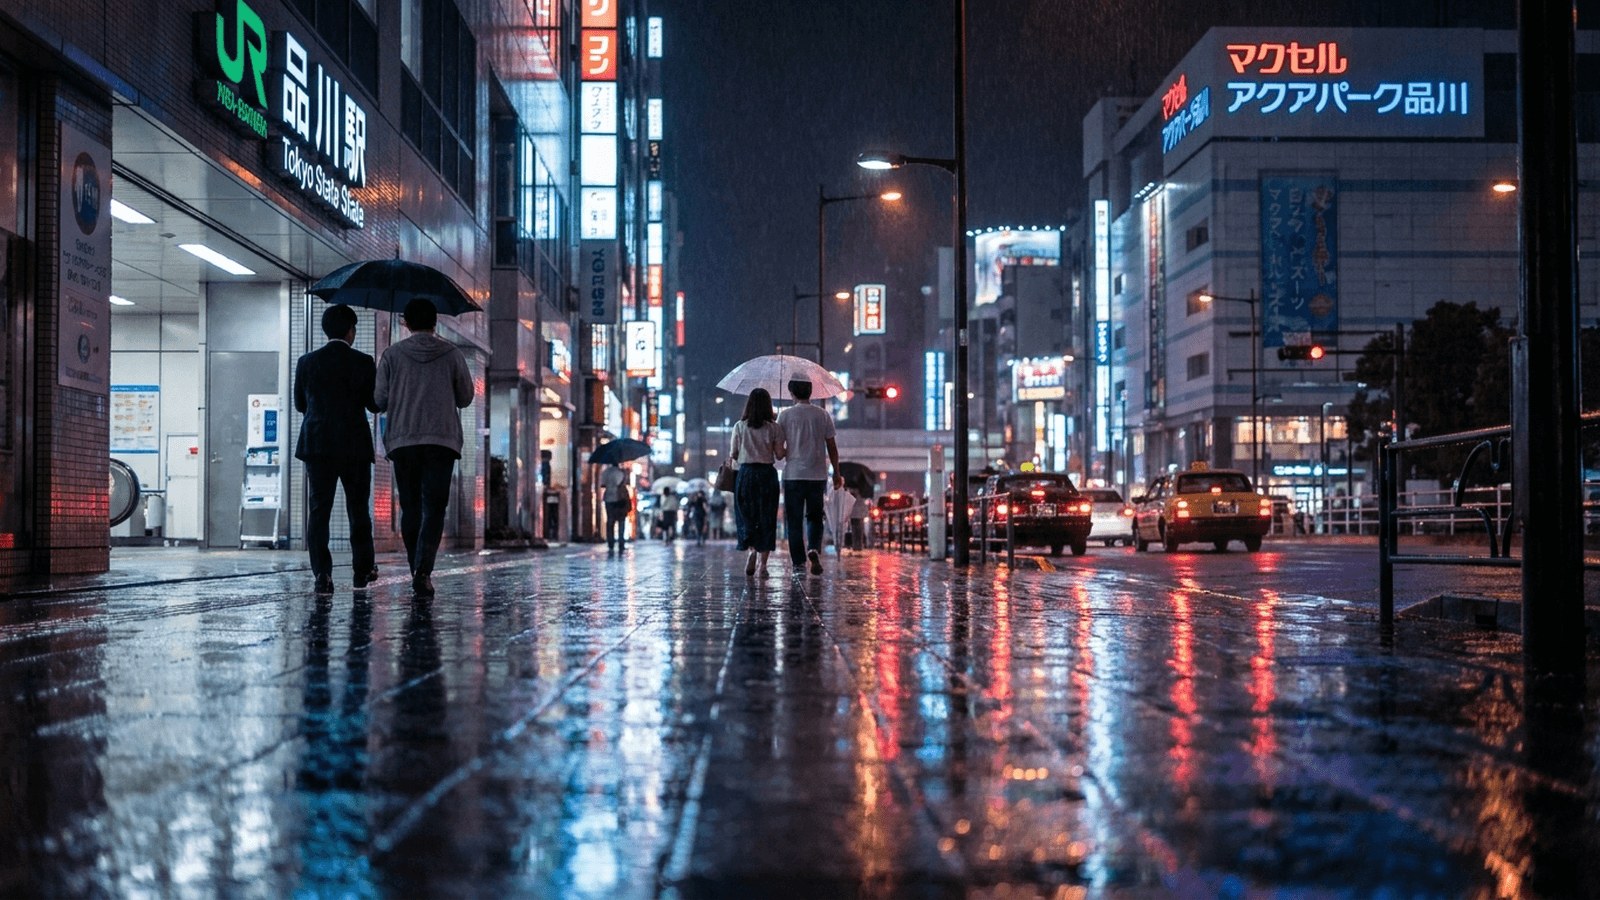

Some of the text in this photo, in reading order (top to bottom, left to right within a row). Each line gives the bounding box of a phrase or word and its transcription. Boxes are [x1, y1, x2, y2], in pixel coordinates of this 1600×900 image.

[216, 0, 268, 110] JR
[1226, 42, 1347, 74] マクセル
[282, 32, 367, 189] 品川駅
[1227, 81, 1468, 115] アクアパーク品川
[282, 135, 314, 190] Tokyo
